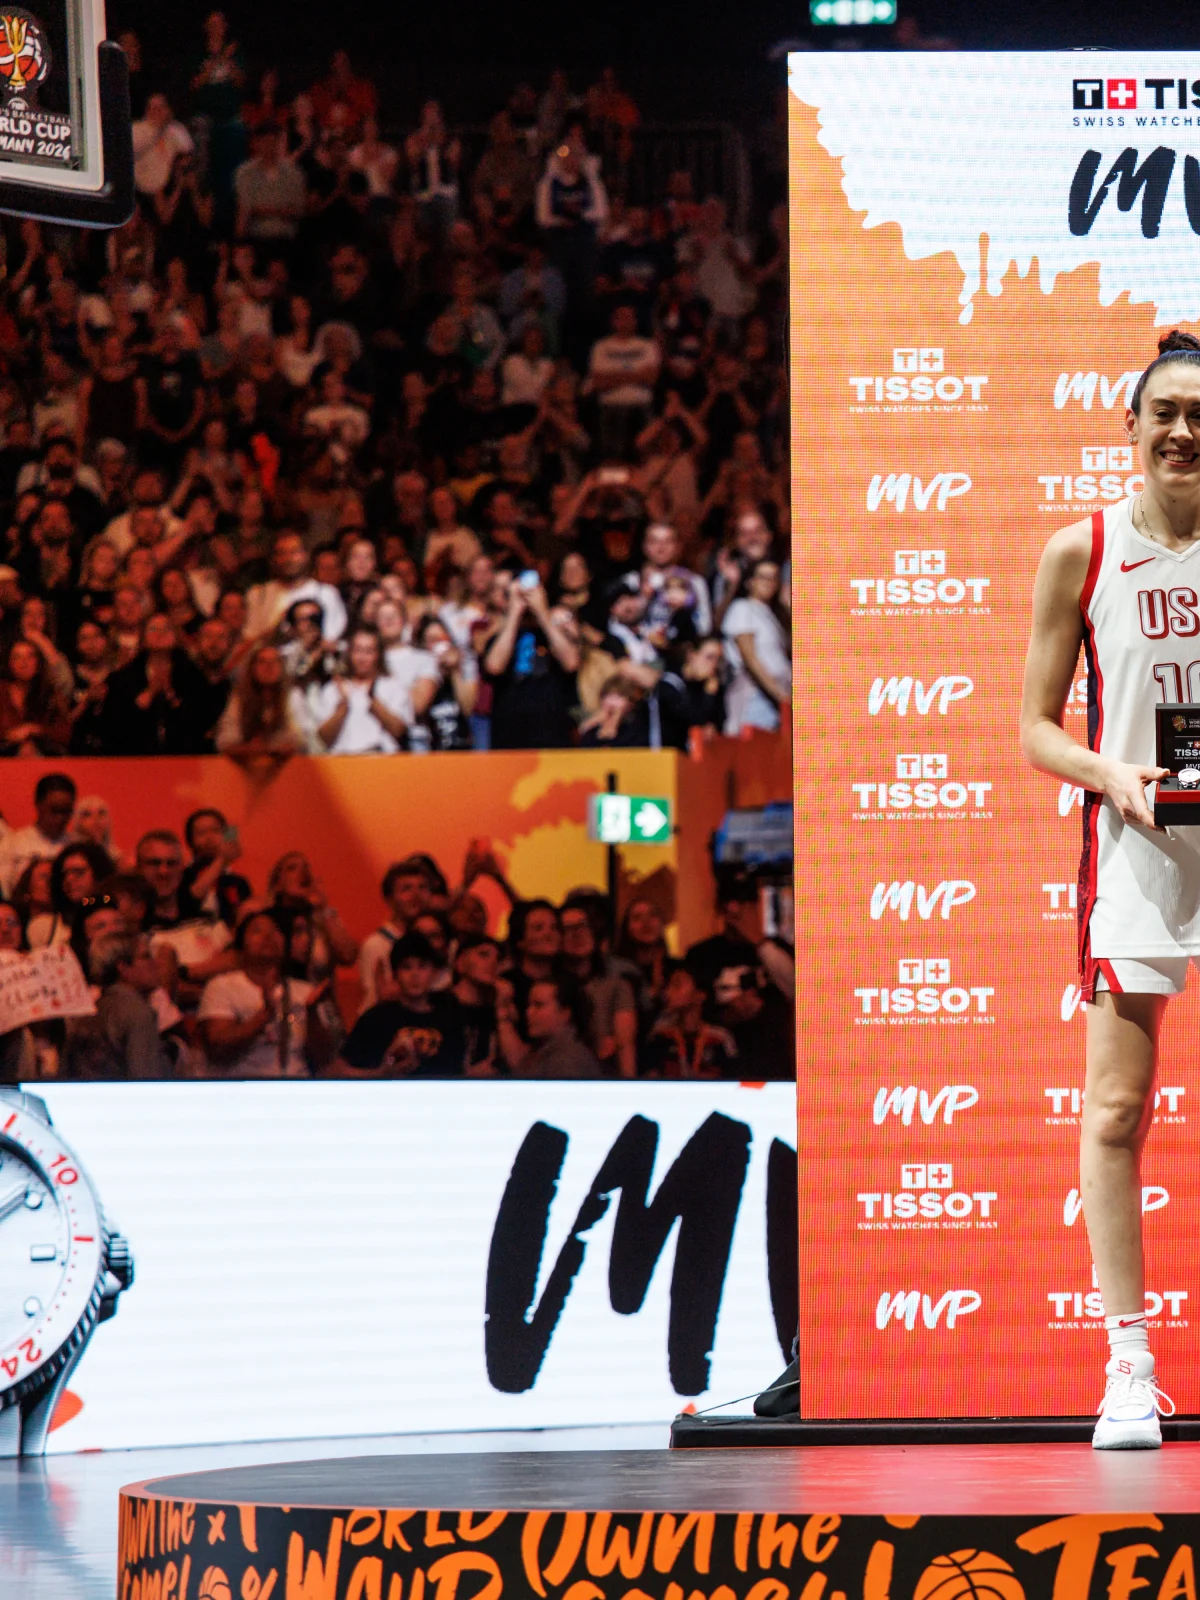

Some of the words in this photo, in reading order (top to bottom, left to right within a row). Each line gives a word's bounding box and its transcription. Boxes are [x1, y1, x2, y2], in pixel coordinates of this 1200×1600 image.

[0, 116, 32, 135] RLD
[35, 122, 71, 141] CUP
[1073, 116, 1125, 127] SWISS
[0, 135, 35, 153] MANY
[37, 140, 71, 161] 2026
[848, 376, 988, 402] TISSOT
[866, 472, 972, 513] MVP
[1037, 475, 1144, 501] TISSO
[850, 577, 990, 604] TISSOT
[868, 675, 974, 716] MVP
[852, 782, 992, 808] TISSOT
[870, 880, 976, 920] MVP
[855, 987, 994, 1013] TISSOT
[873, 1085, 978, 1125] MVP
[50, 1153, 79, 1186] 10
[857, 1192, 997, 1218] TISSOT
[876, 1290, 981, 1330] MVP
[1047, 1291, 1188, 1318] TISOT
